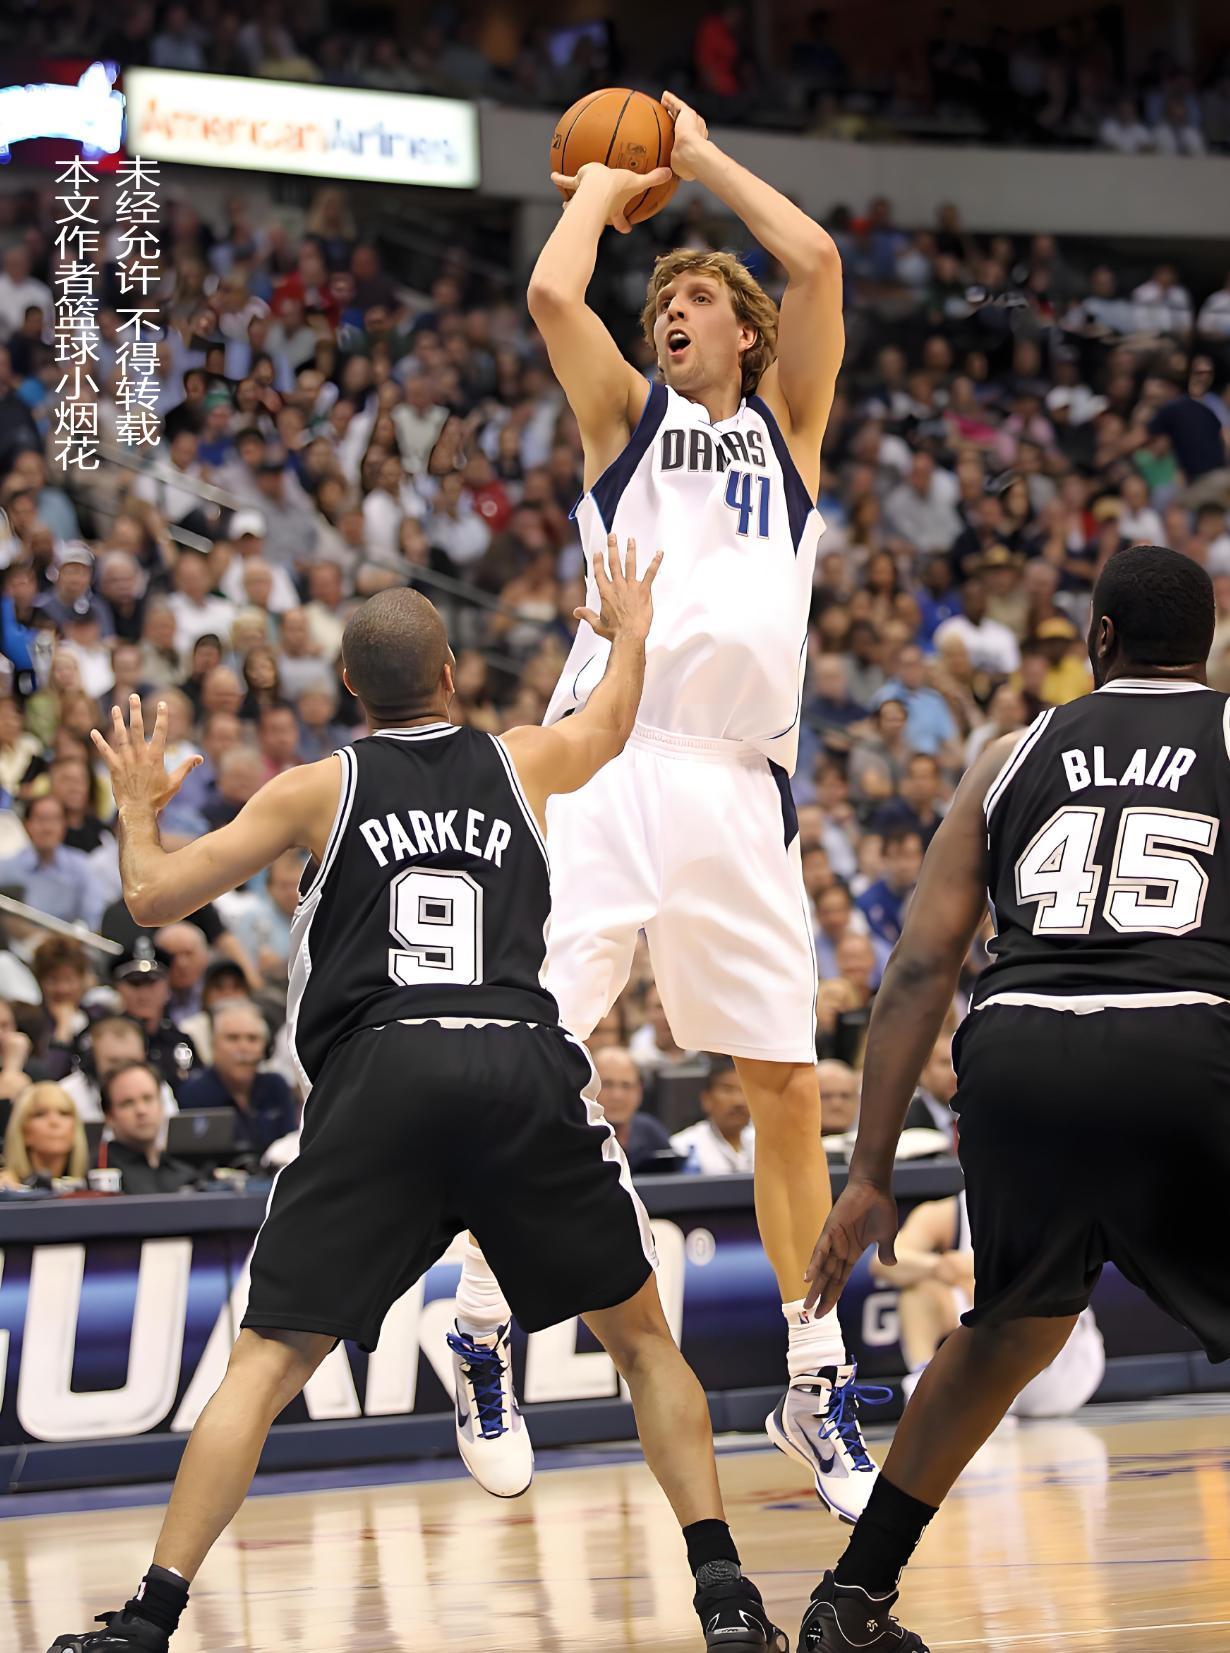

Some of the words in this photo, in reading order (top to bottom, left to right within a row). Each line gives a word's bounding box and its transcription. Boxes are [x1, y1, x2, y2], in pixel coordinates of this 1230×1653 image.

[723, 468, 770, 540] 41
[1061, 745, 1197, 793] BLAIR
[358, 807, 512, 868] PARKER
[1014, 805, 1220, 936] 45
[388, 866, 484, 987] 9
